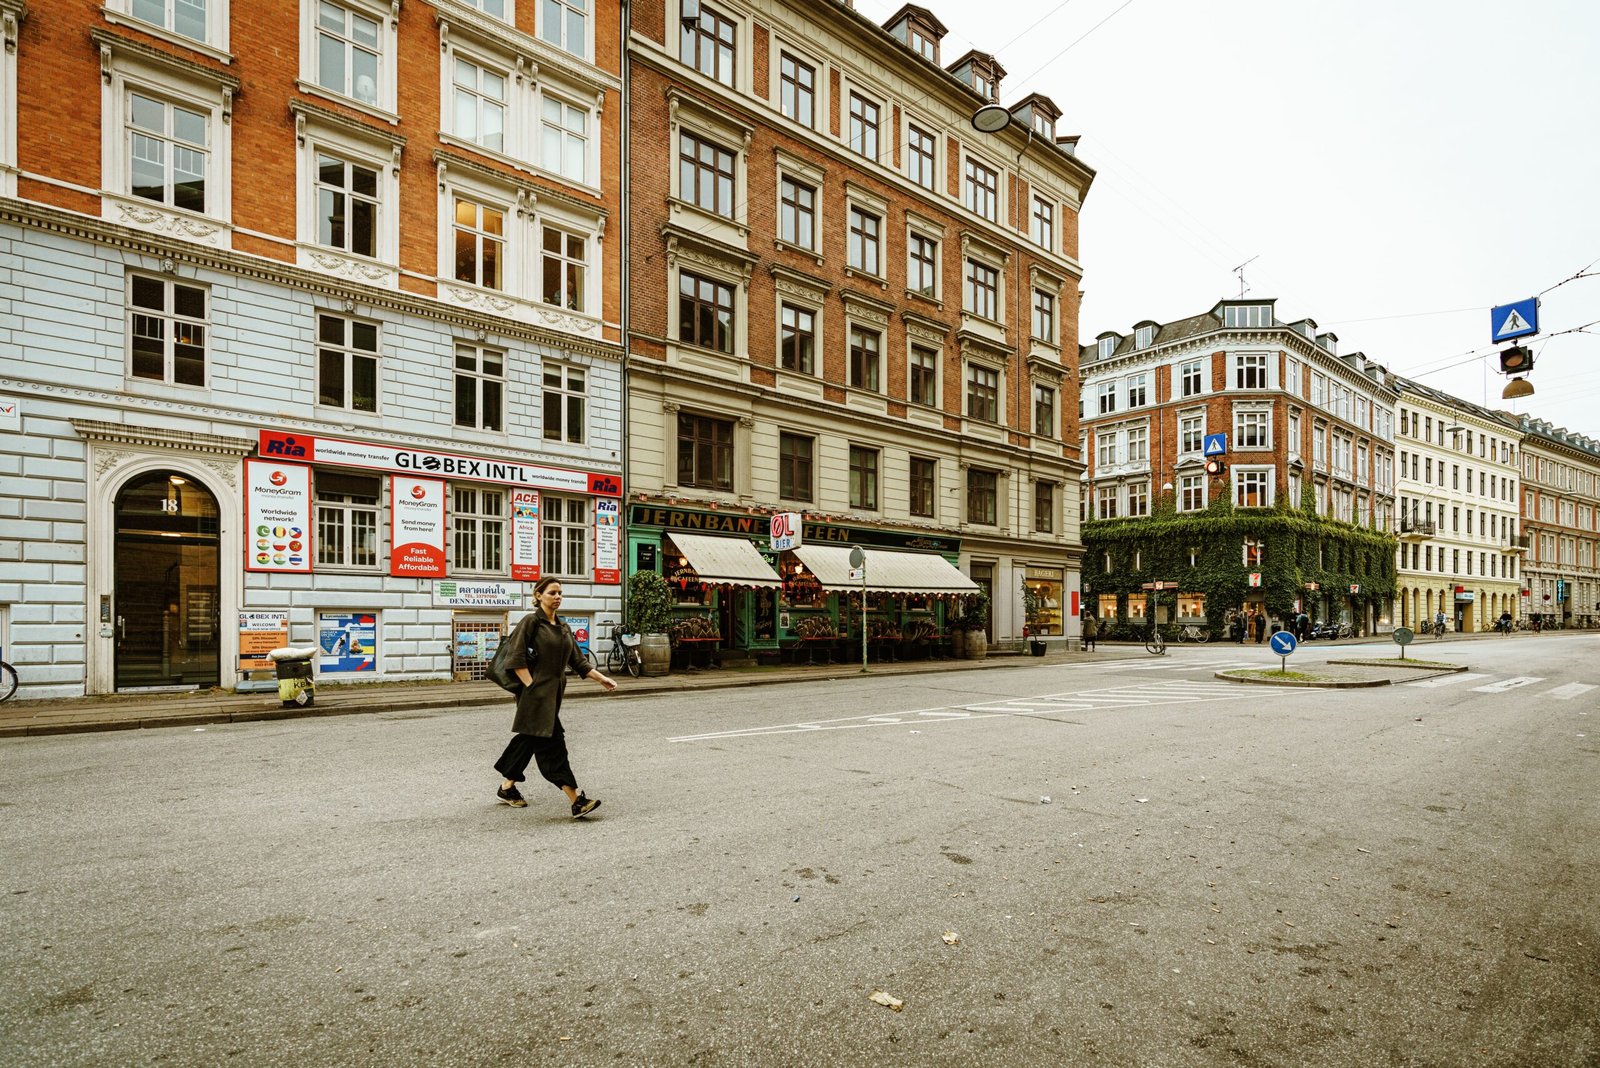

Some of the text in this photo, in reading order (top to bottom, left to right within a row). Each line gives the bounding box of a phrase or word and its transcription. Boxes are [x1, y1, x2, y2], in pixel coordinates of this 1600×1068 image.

[267, 437, 306, 457] Ria
[315, 447, 390, 461] worldwide money transfer
[487, 463, 527, 482] INTL
[255, 486, 302, 496] MoneyGram
[593, 478, 618, 494] Ria
[398, 499, 438, 509] MoneyGram
[515, 493, 538, 504] ACE
[160, 498, 178, 512] 18
[597, 500, 617, 512] Ria
[261, 508, 298, 516] Worldwide
[263, 515, 294, 523] network!
[639, 508, 764, 534] JERNBANE
[771, 515, 794, 538] ØL
[775, 539, 792, 549] BIER
[403, 555, 434, 564] Reliable
[398, 563, 439, 572] Affordable
